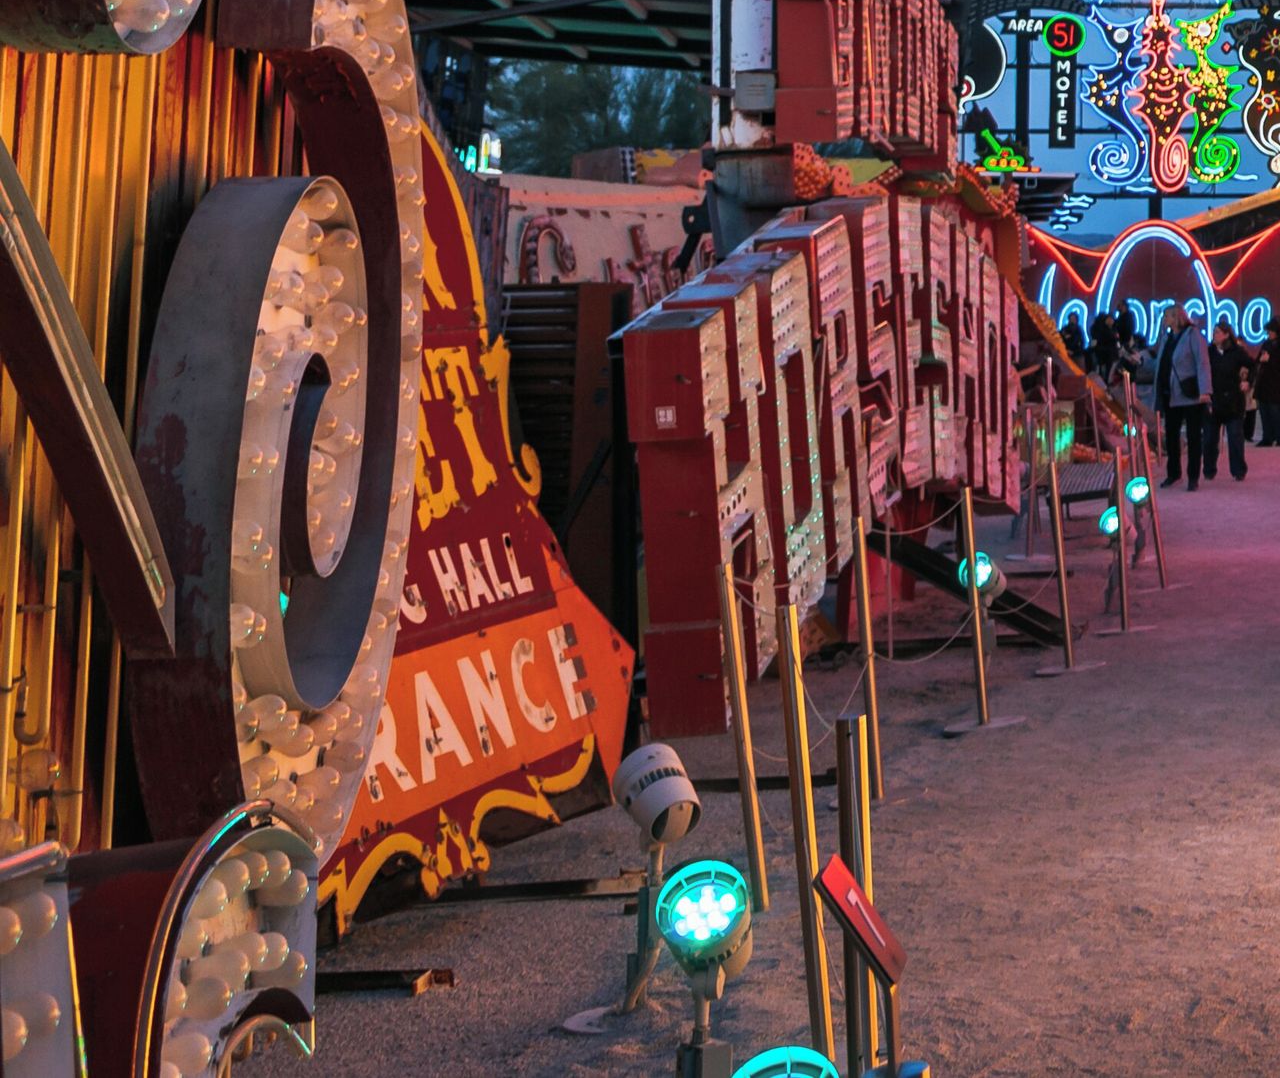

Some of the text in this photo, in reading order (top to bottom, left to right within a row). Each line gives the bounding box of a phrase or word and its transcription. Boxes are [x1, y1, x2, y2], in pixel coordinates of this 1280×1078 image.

[1008, 18, 1075, 49] AREA 51
[1055, 59, 1071, 141] MOTEL
[428, 532, 534, 618] HALL
